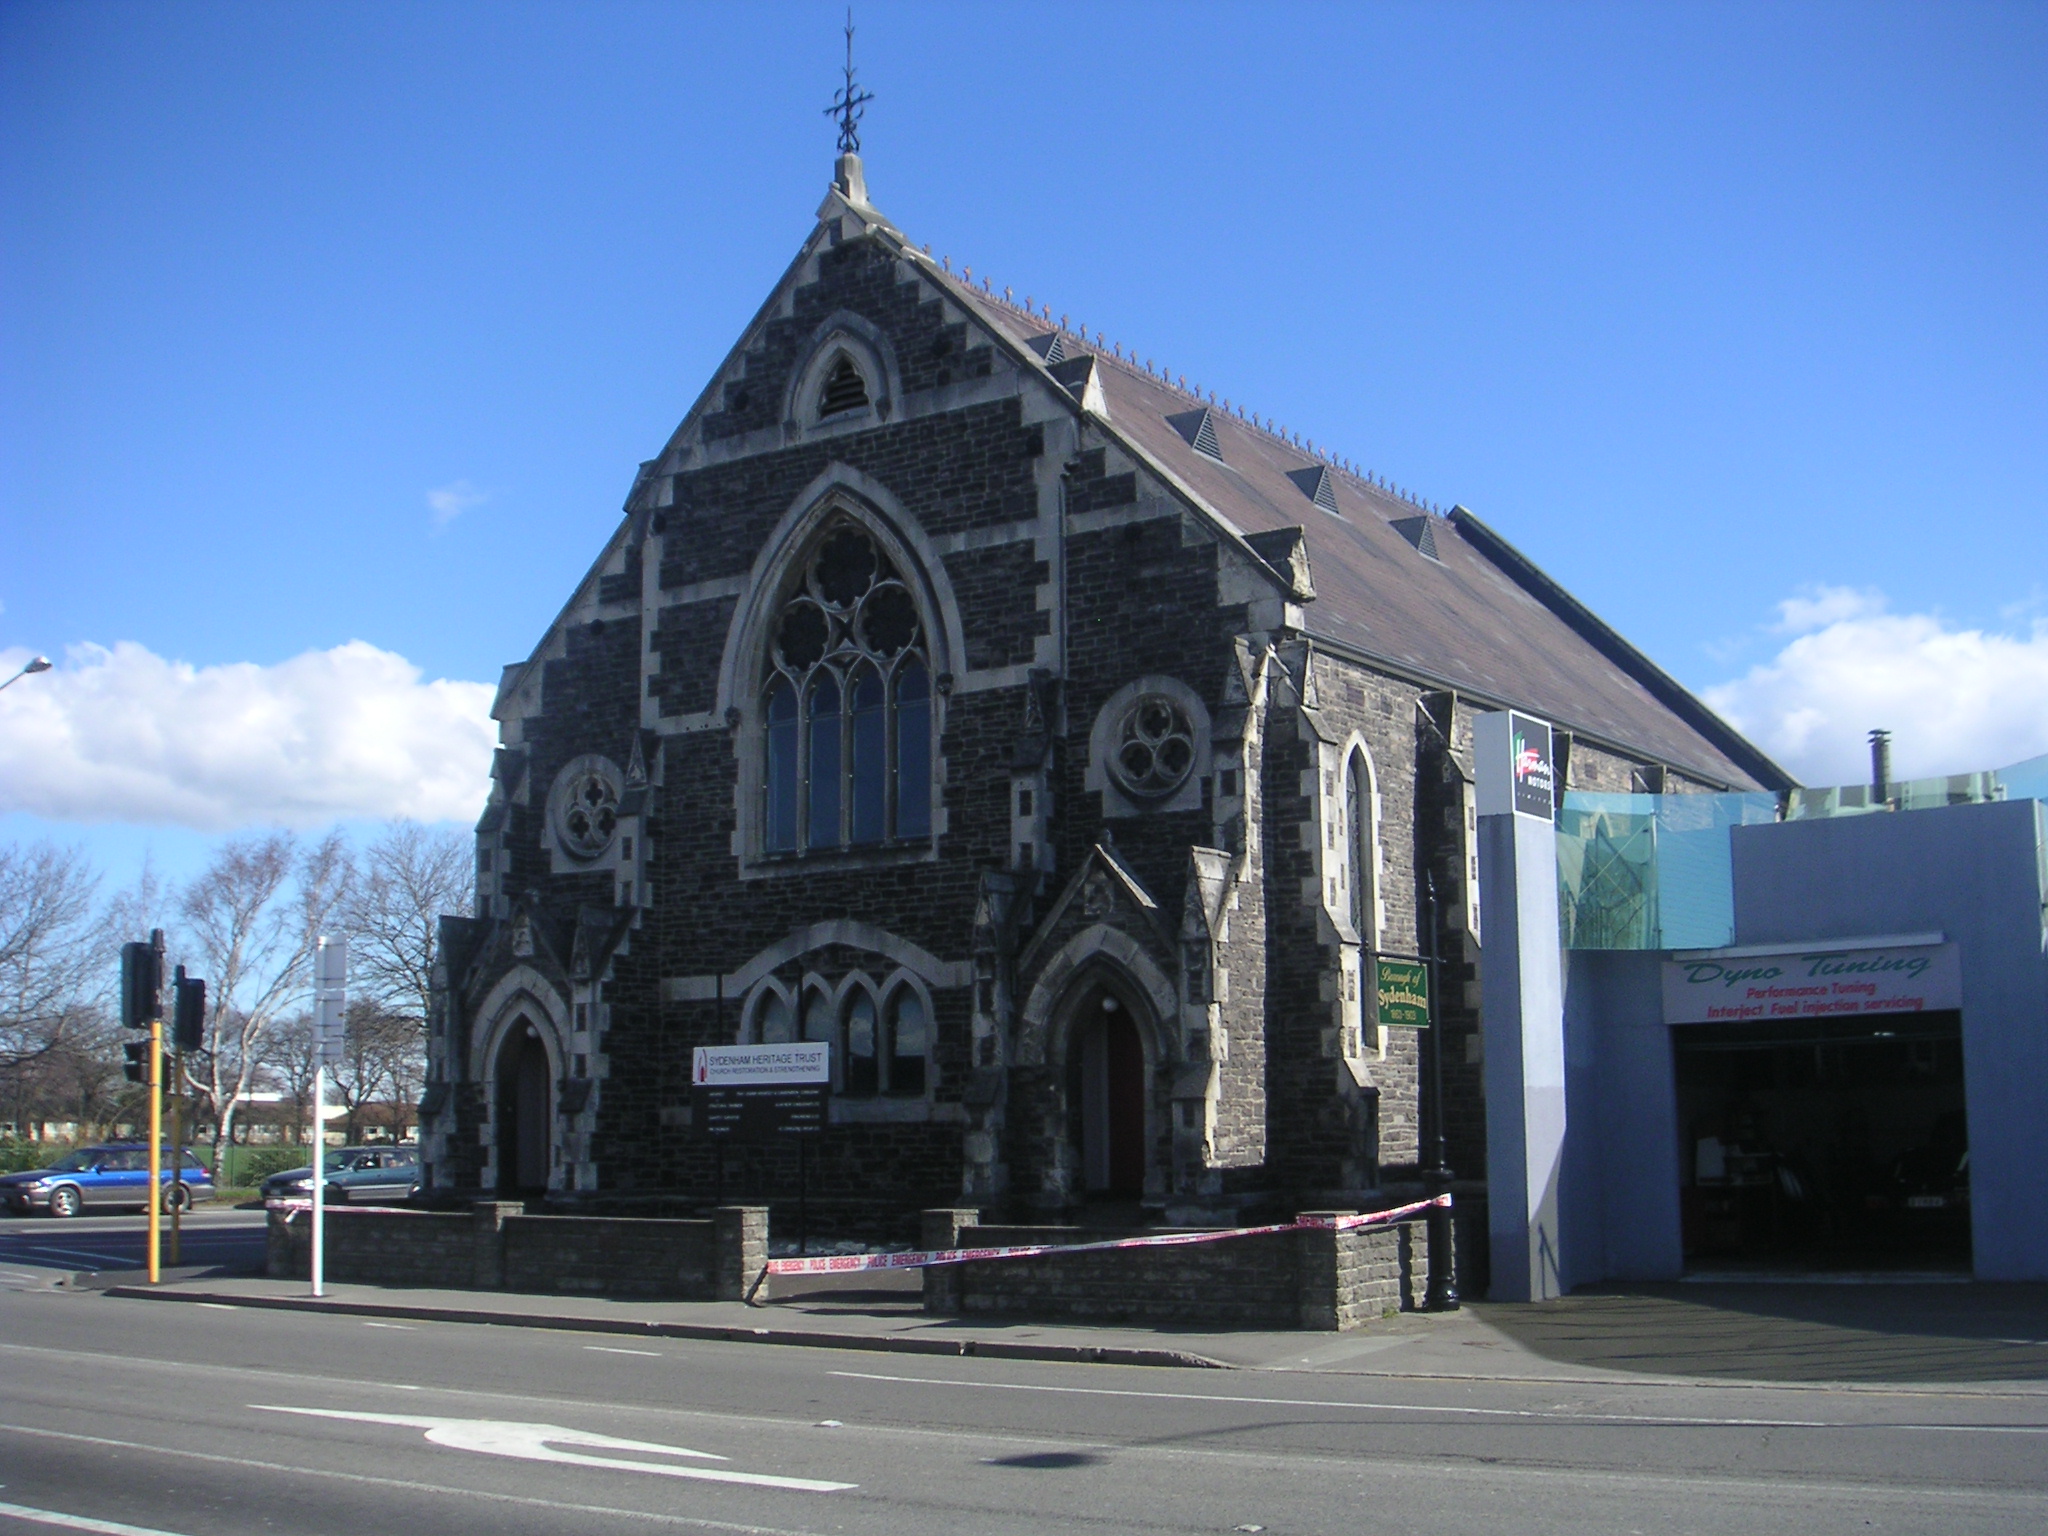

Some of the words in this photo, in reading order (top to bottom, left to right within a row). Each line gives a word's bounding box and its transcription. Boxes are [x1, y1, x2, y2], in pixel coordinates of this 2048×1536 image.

[1683, 962, 1783, 987] Dyno
[1801, 953, 1931, 978] Tuning
[1378, 986, 1426, 1009] Sydenham
[1746, 985, 1828, 998] Performance
[1832, 981, 1876, 996] Tuning
[1707, 1003, 1764, 1019] Interject
[1771, 1002, 1798, 1015] Fuel
[1802, 999, 1859, 1016] injection
[1864, 996, 1924, 1011] servicing
[709, 1056, 751, 1067] SYDENHAM
[752, 1053, 793, 1065] HERITAGE
[795, 1052, 822, 1063] TRUST
[892, 1252, 929, 1266] EMERGENCY
